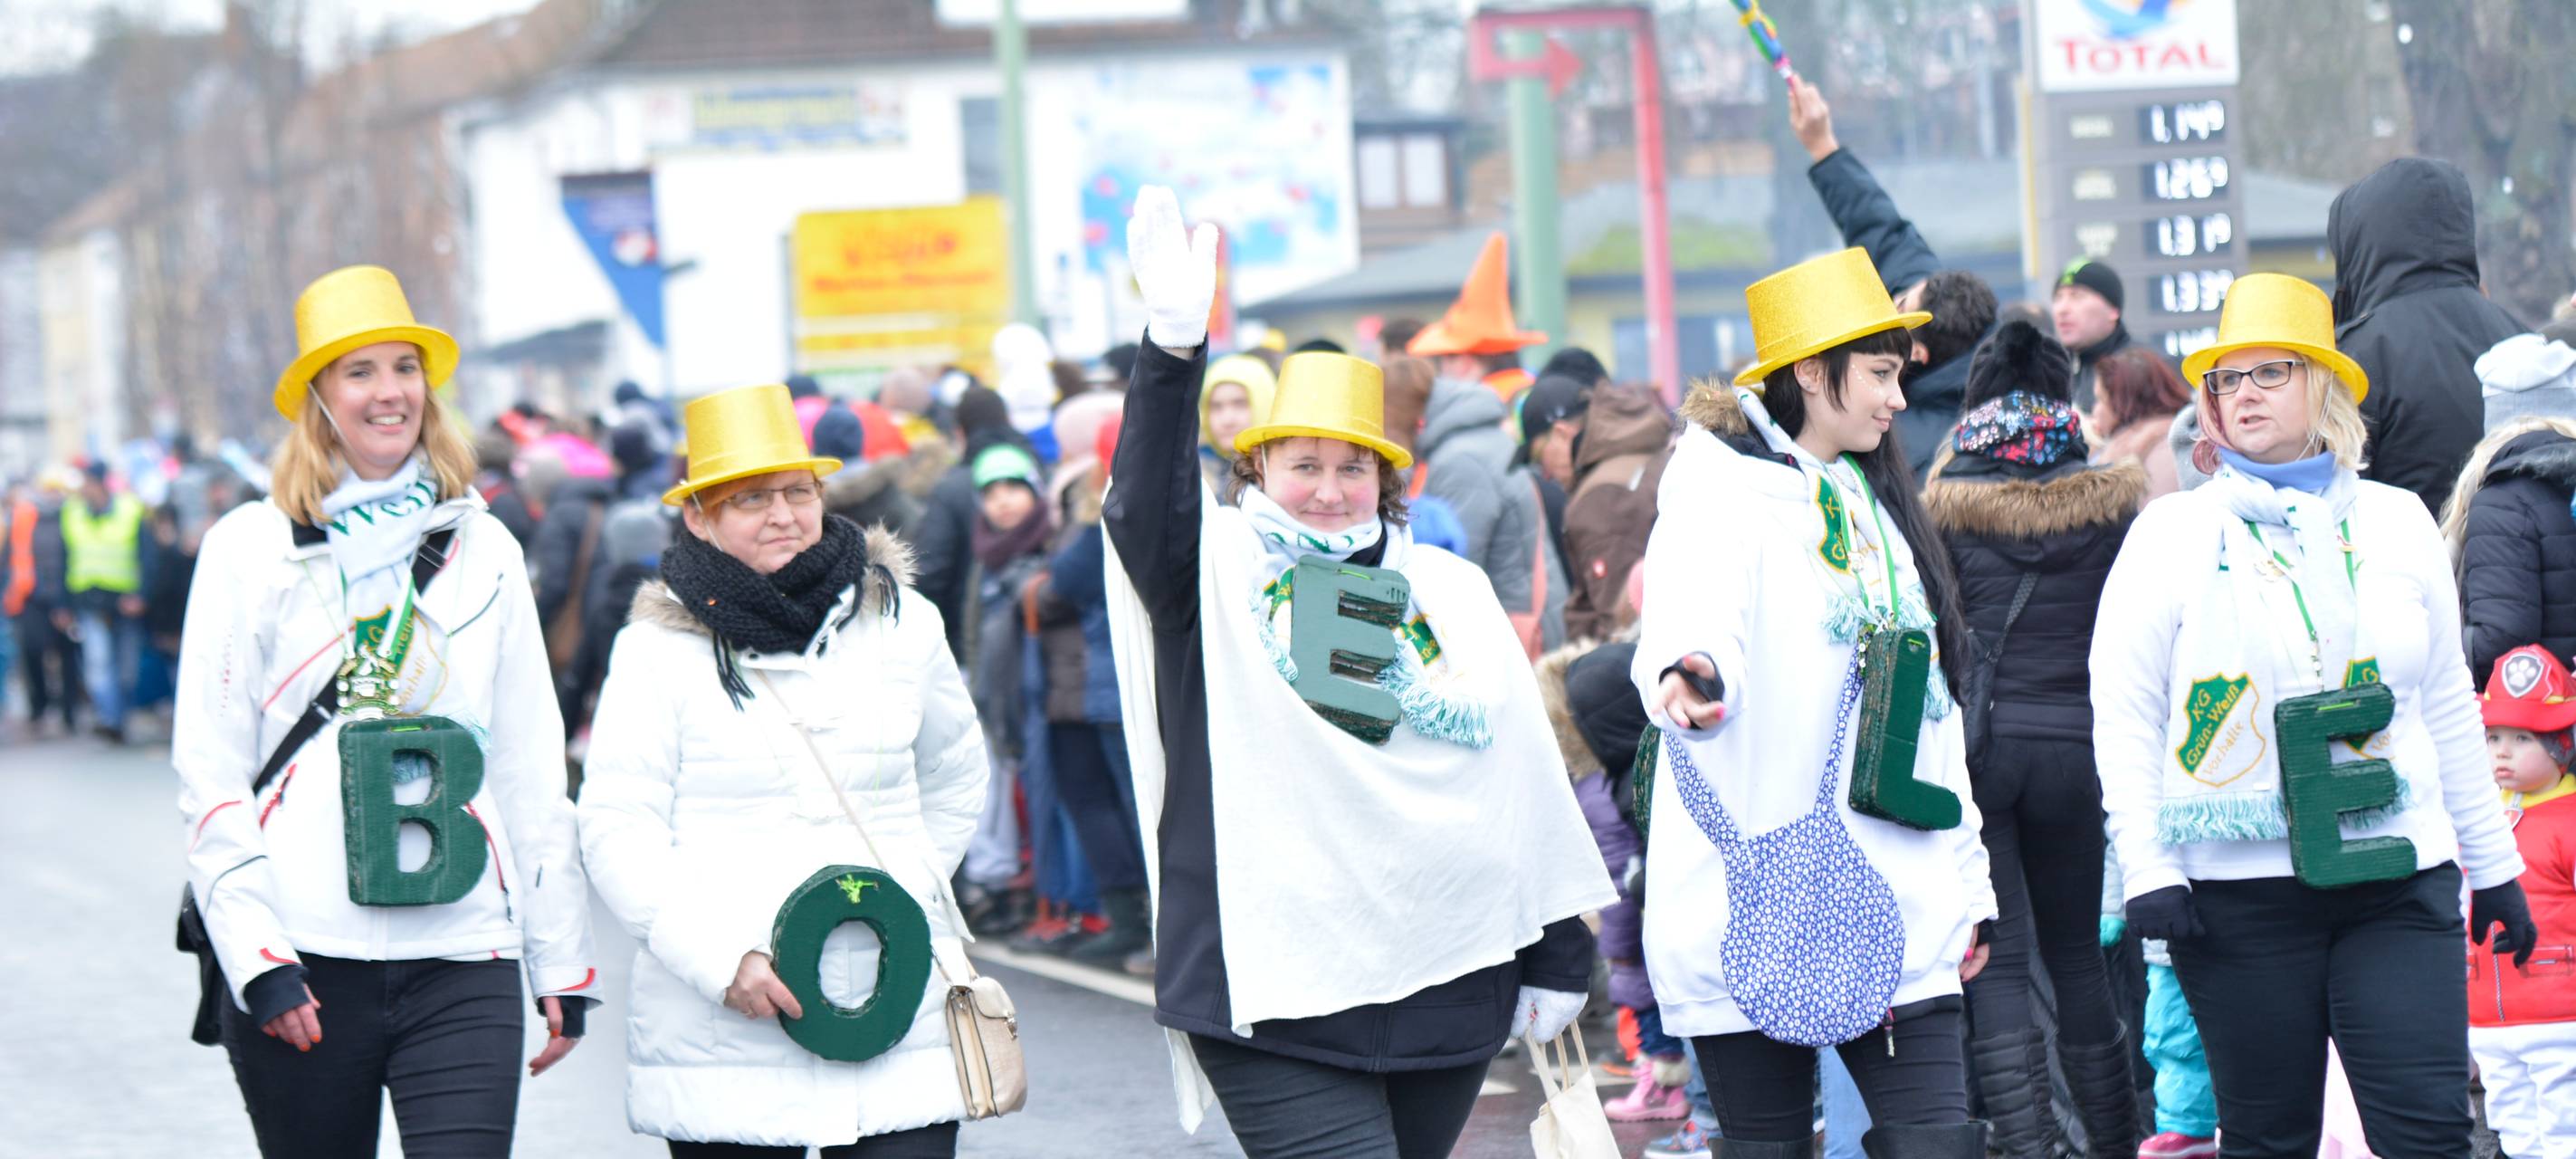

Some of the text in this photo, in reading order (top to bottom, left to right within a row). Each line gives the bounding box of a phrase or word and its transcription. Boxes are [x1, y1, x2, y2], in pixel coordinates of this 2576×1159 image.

[2059, 38, 2227, 74] TOTAL
[1290, 554, 1410, 745] E
[1848, 629, 1962, 831] L
[2191, 687, 2211, 723] KG
[339, 714, 488, 906] B
[2274, 682, 2418, 889] E
[771, 864, 932, 1062] O
